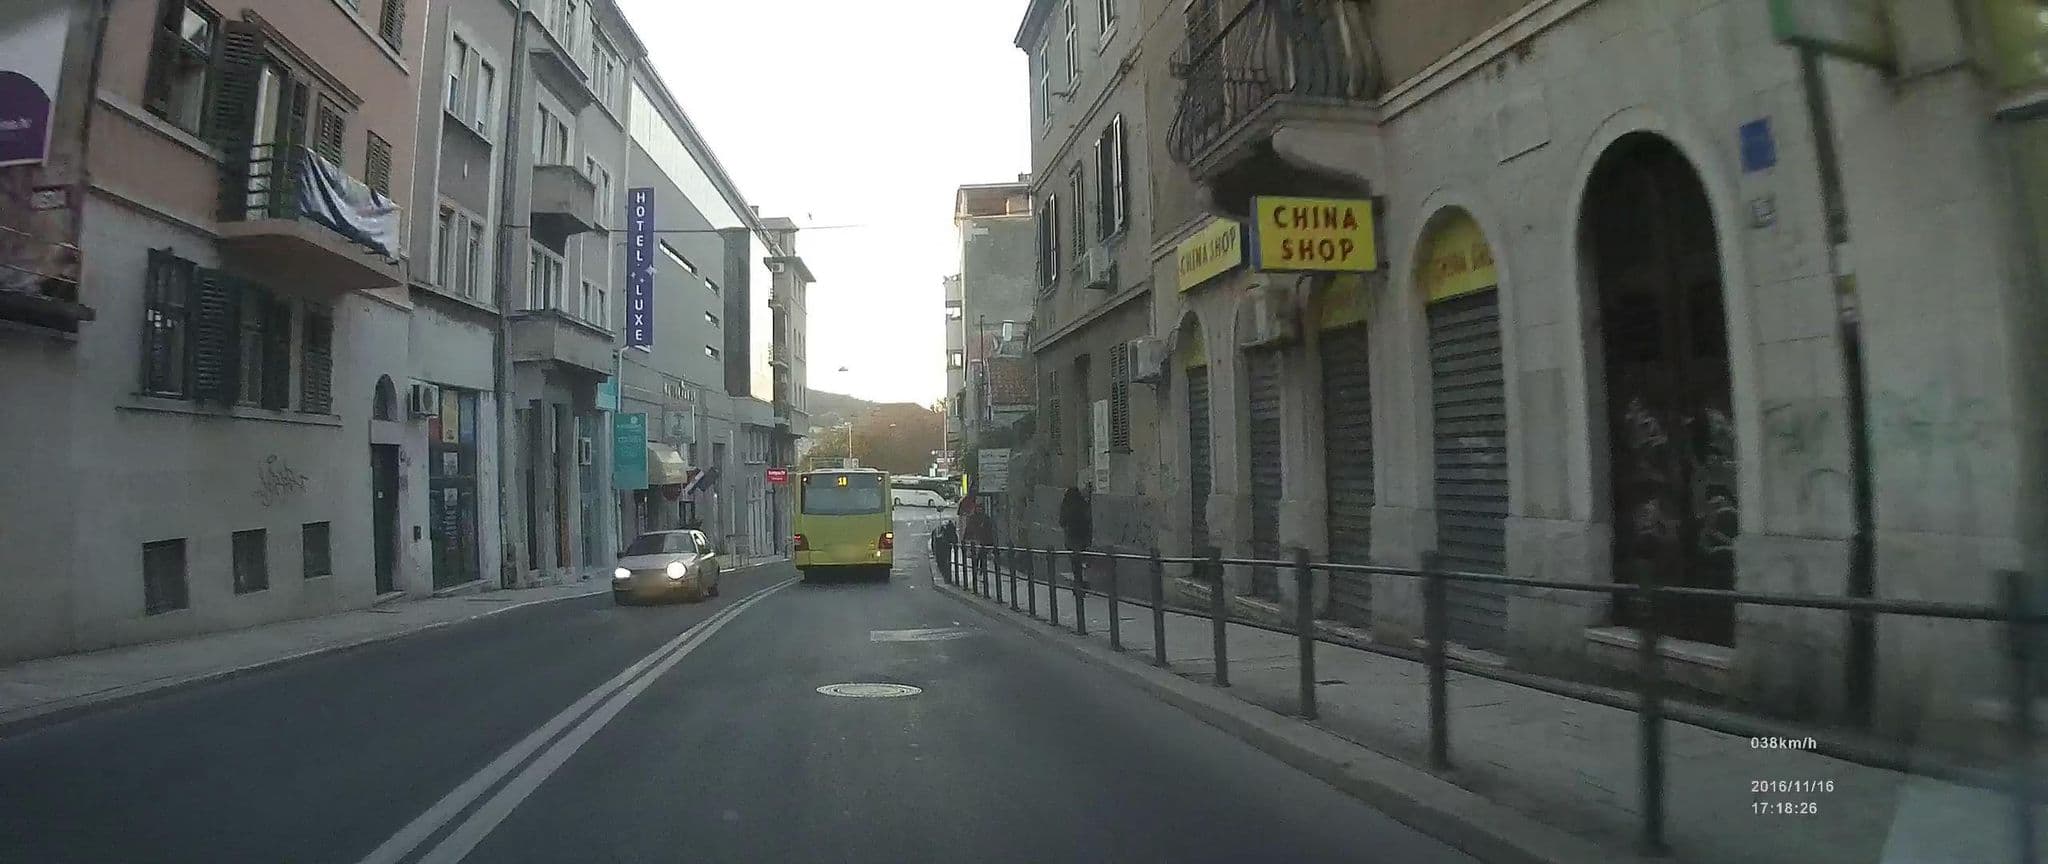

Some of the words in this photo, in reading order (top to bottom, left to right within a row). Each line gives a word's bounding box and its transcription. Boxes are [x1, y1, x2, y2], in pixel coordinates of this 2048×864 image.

[636, 191, 646, 262] HOTEL
[1273, 206, 1359, 231] CHINA
[1179, 246, 1208, 275] CHINA
[1209, 226, 1237, 261] SHOP
[1280, 238, 1354, 263] SHOP
[634, 284, 644, 341] LUXE
